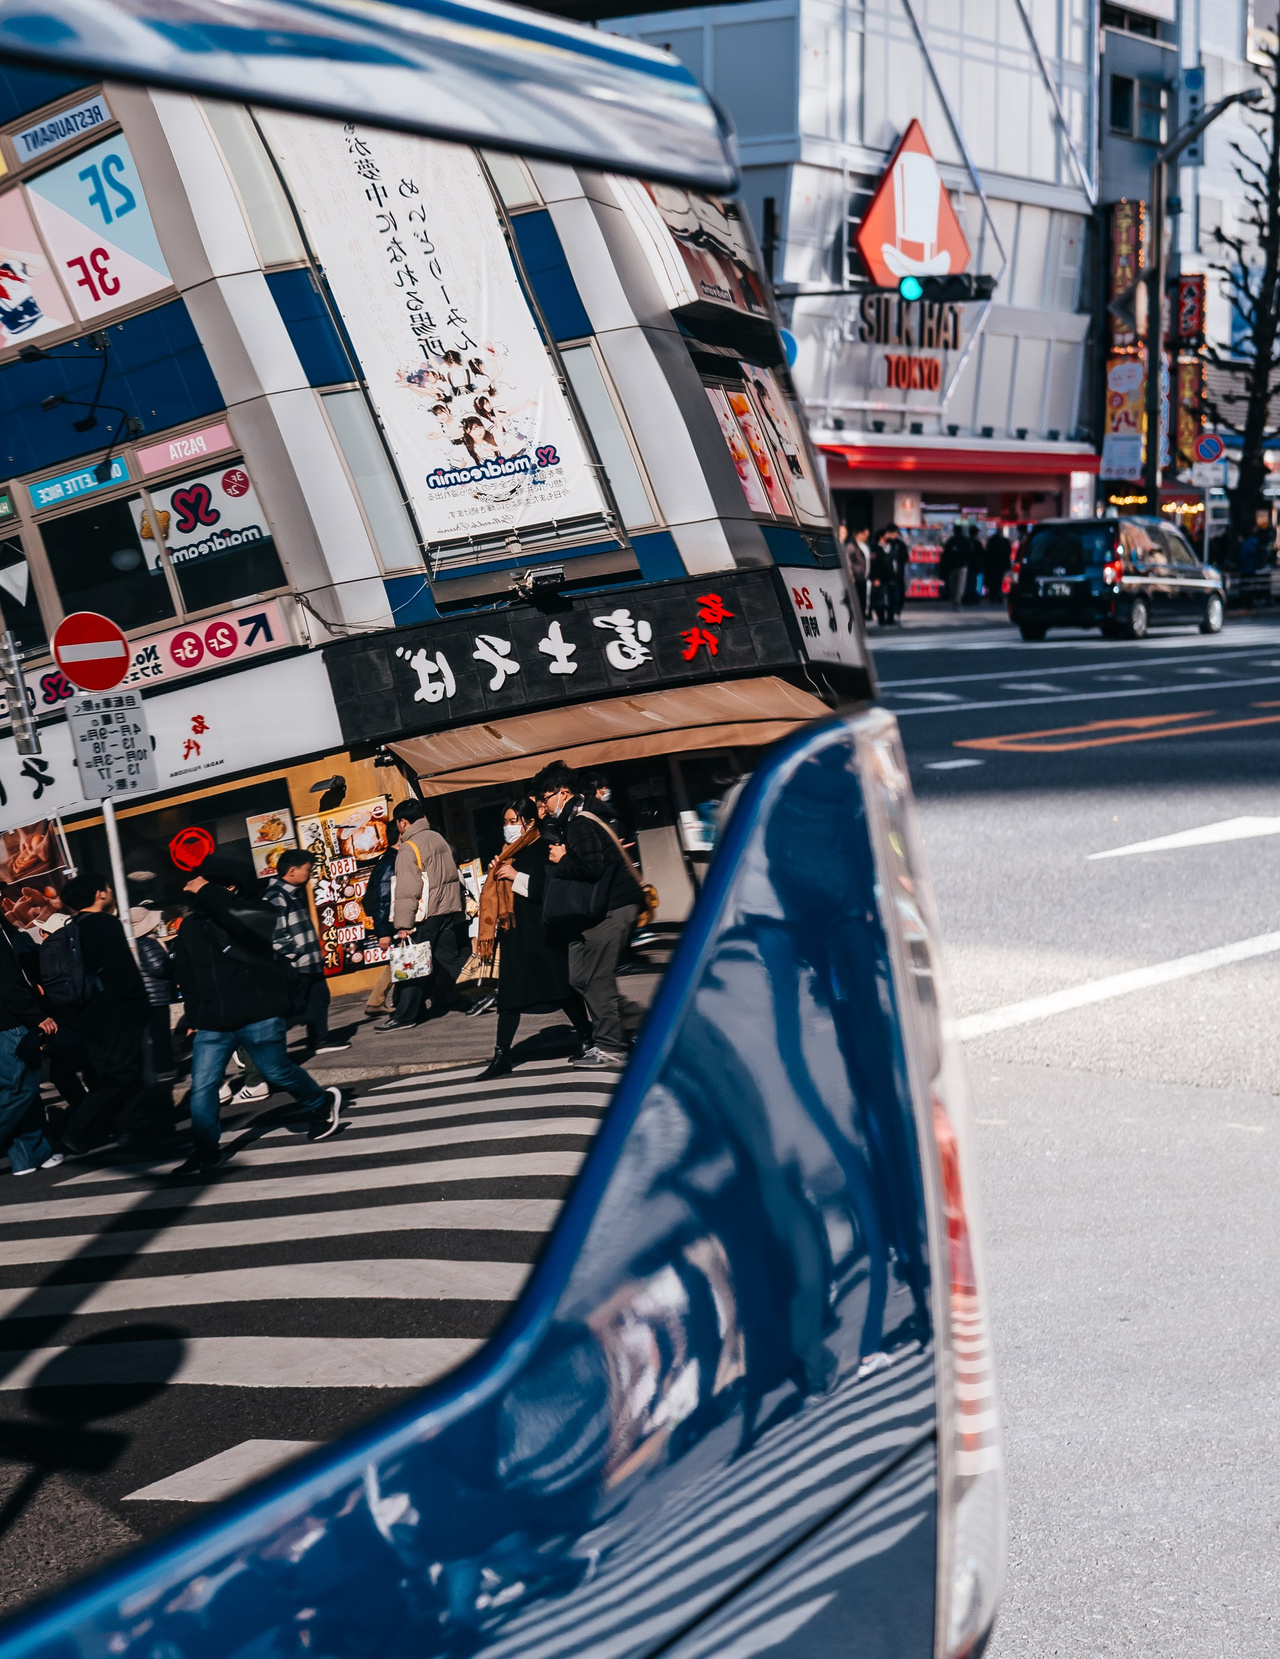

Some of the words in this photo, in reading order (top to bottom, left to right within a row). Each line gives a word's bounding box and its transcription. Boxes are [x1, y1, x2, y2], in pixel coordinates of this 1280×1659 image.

[858, 294, 915, 347] SILK
[923, 300, 964, 350] HAT
[885, 354, 940, 390] TOKYO
